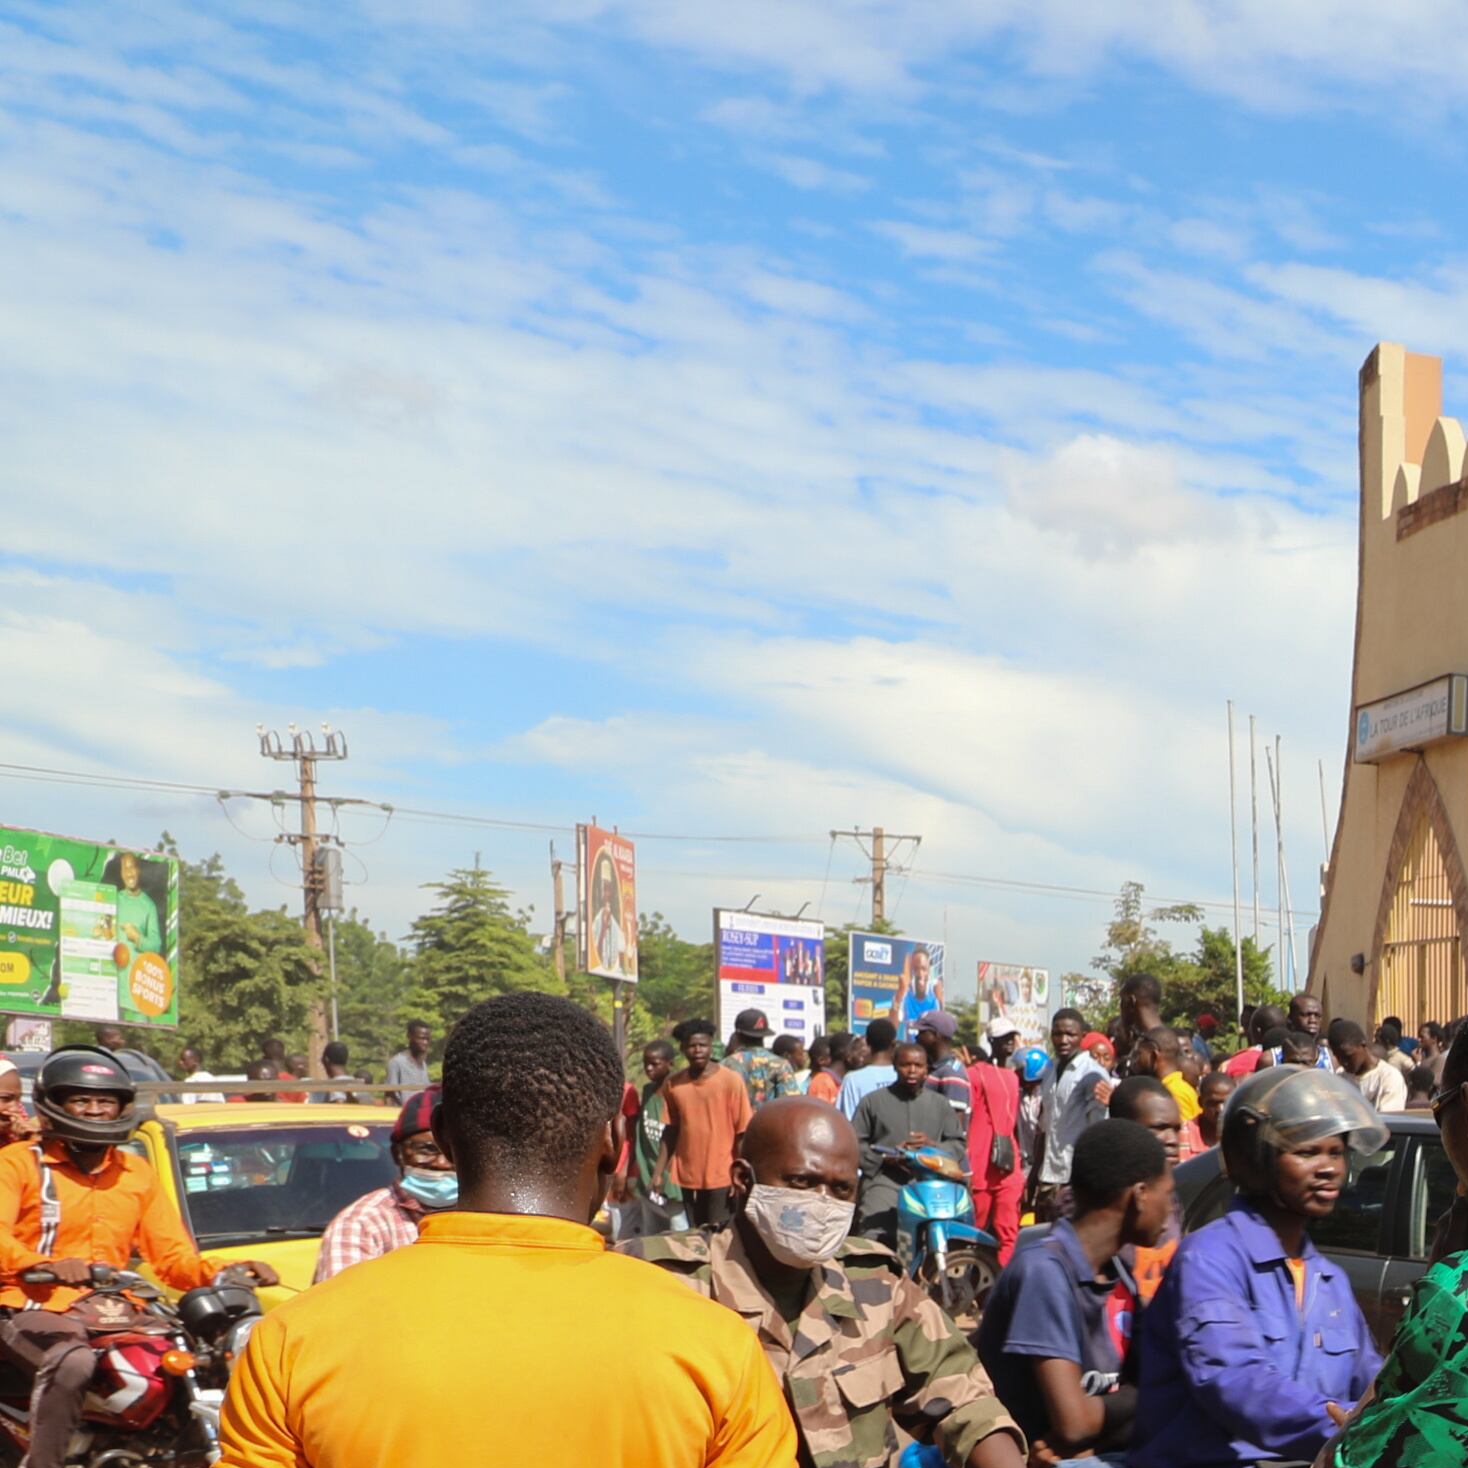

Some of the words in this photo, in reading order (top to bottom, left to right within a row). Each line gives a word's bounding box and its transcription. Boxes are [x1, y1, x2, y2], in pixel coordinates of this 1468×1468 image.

[1379, 711, 1399, 735] TOUR
[1399, 711, 1409, 728] DE
[1410, 697, 1447, 724] L'AFRIQUE
[0, 905, 54, 929] MIEUX!
[135, 970, 165, 994] BONUS
